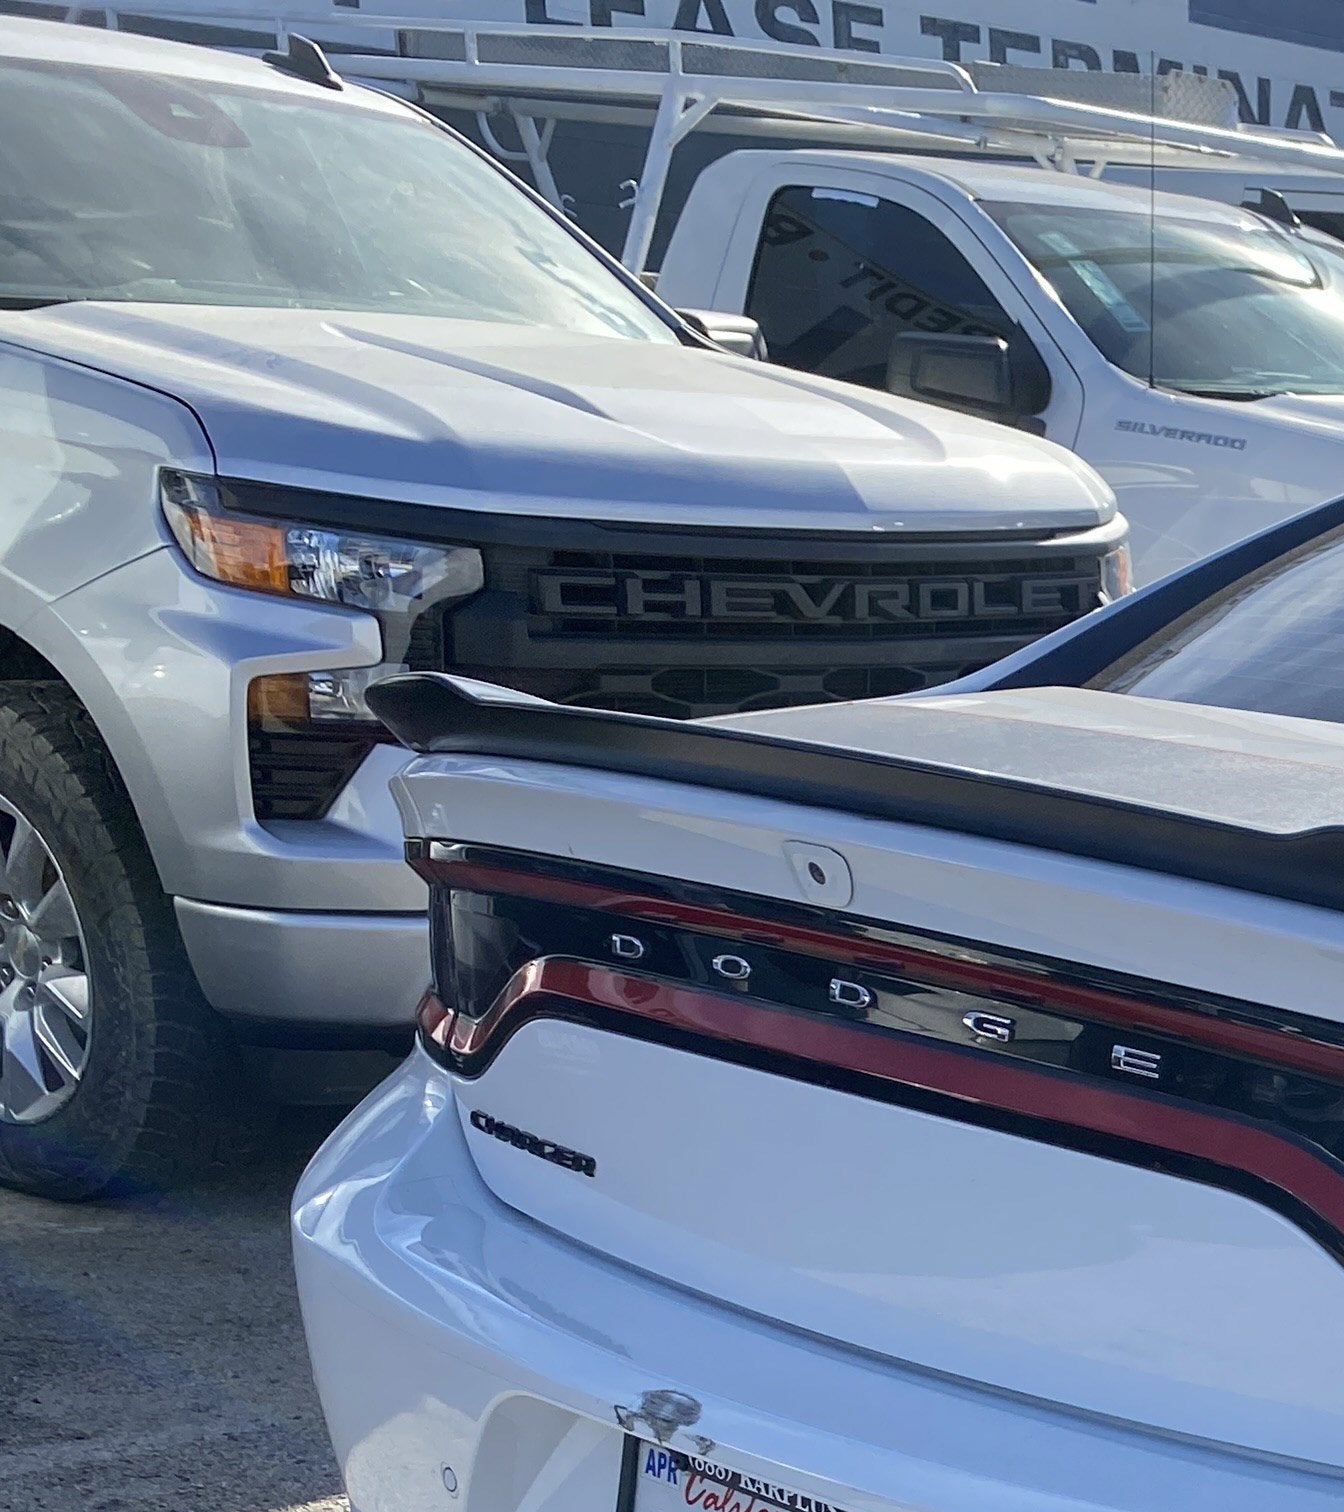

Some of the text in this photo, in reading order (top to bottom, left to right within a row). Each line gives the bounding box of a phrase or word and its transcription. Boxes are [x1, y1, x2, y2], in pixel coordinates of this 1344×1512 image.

[1114, 418, 1248, 451] SILVERADO
[538, 571, 1102, 622] CHEVROLET
[611, 933, 1162, 1080] DODGE
[469, 1109, 597, 1178] CHARGER
[645, 1448, 678, 1486] APR
